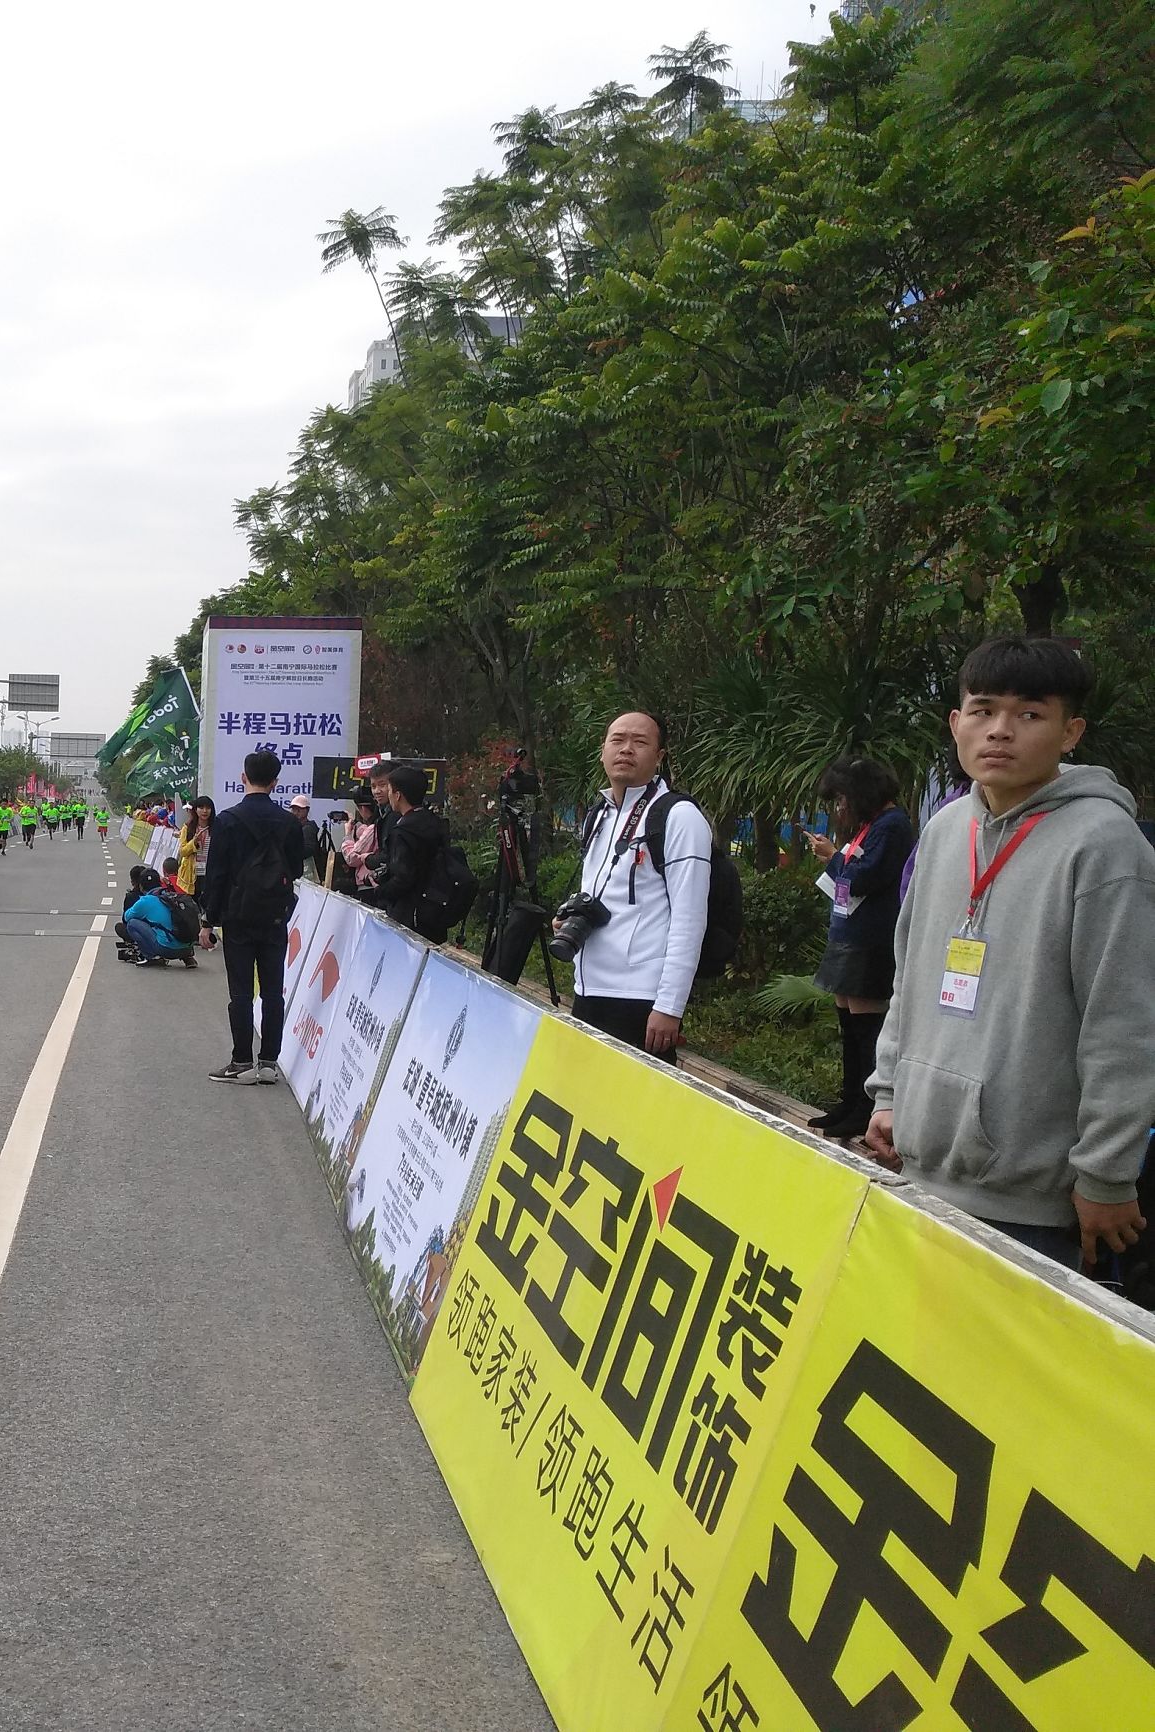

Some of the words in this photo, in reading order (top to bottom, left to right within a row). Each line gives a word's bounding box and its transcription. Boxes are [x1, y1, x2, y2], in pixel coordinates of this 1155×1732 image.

[217, 711, 343, 737] 半程马拉松
[634, 798, 647, 815] EOS
[293, 1004, 324, 1060] LI-NING
